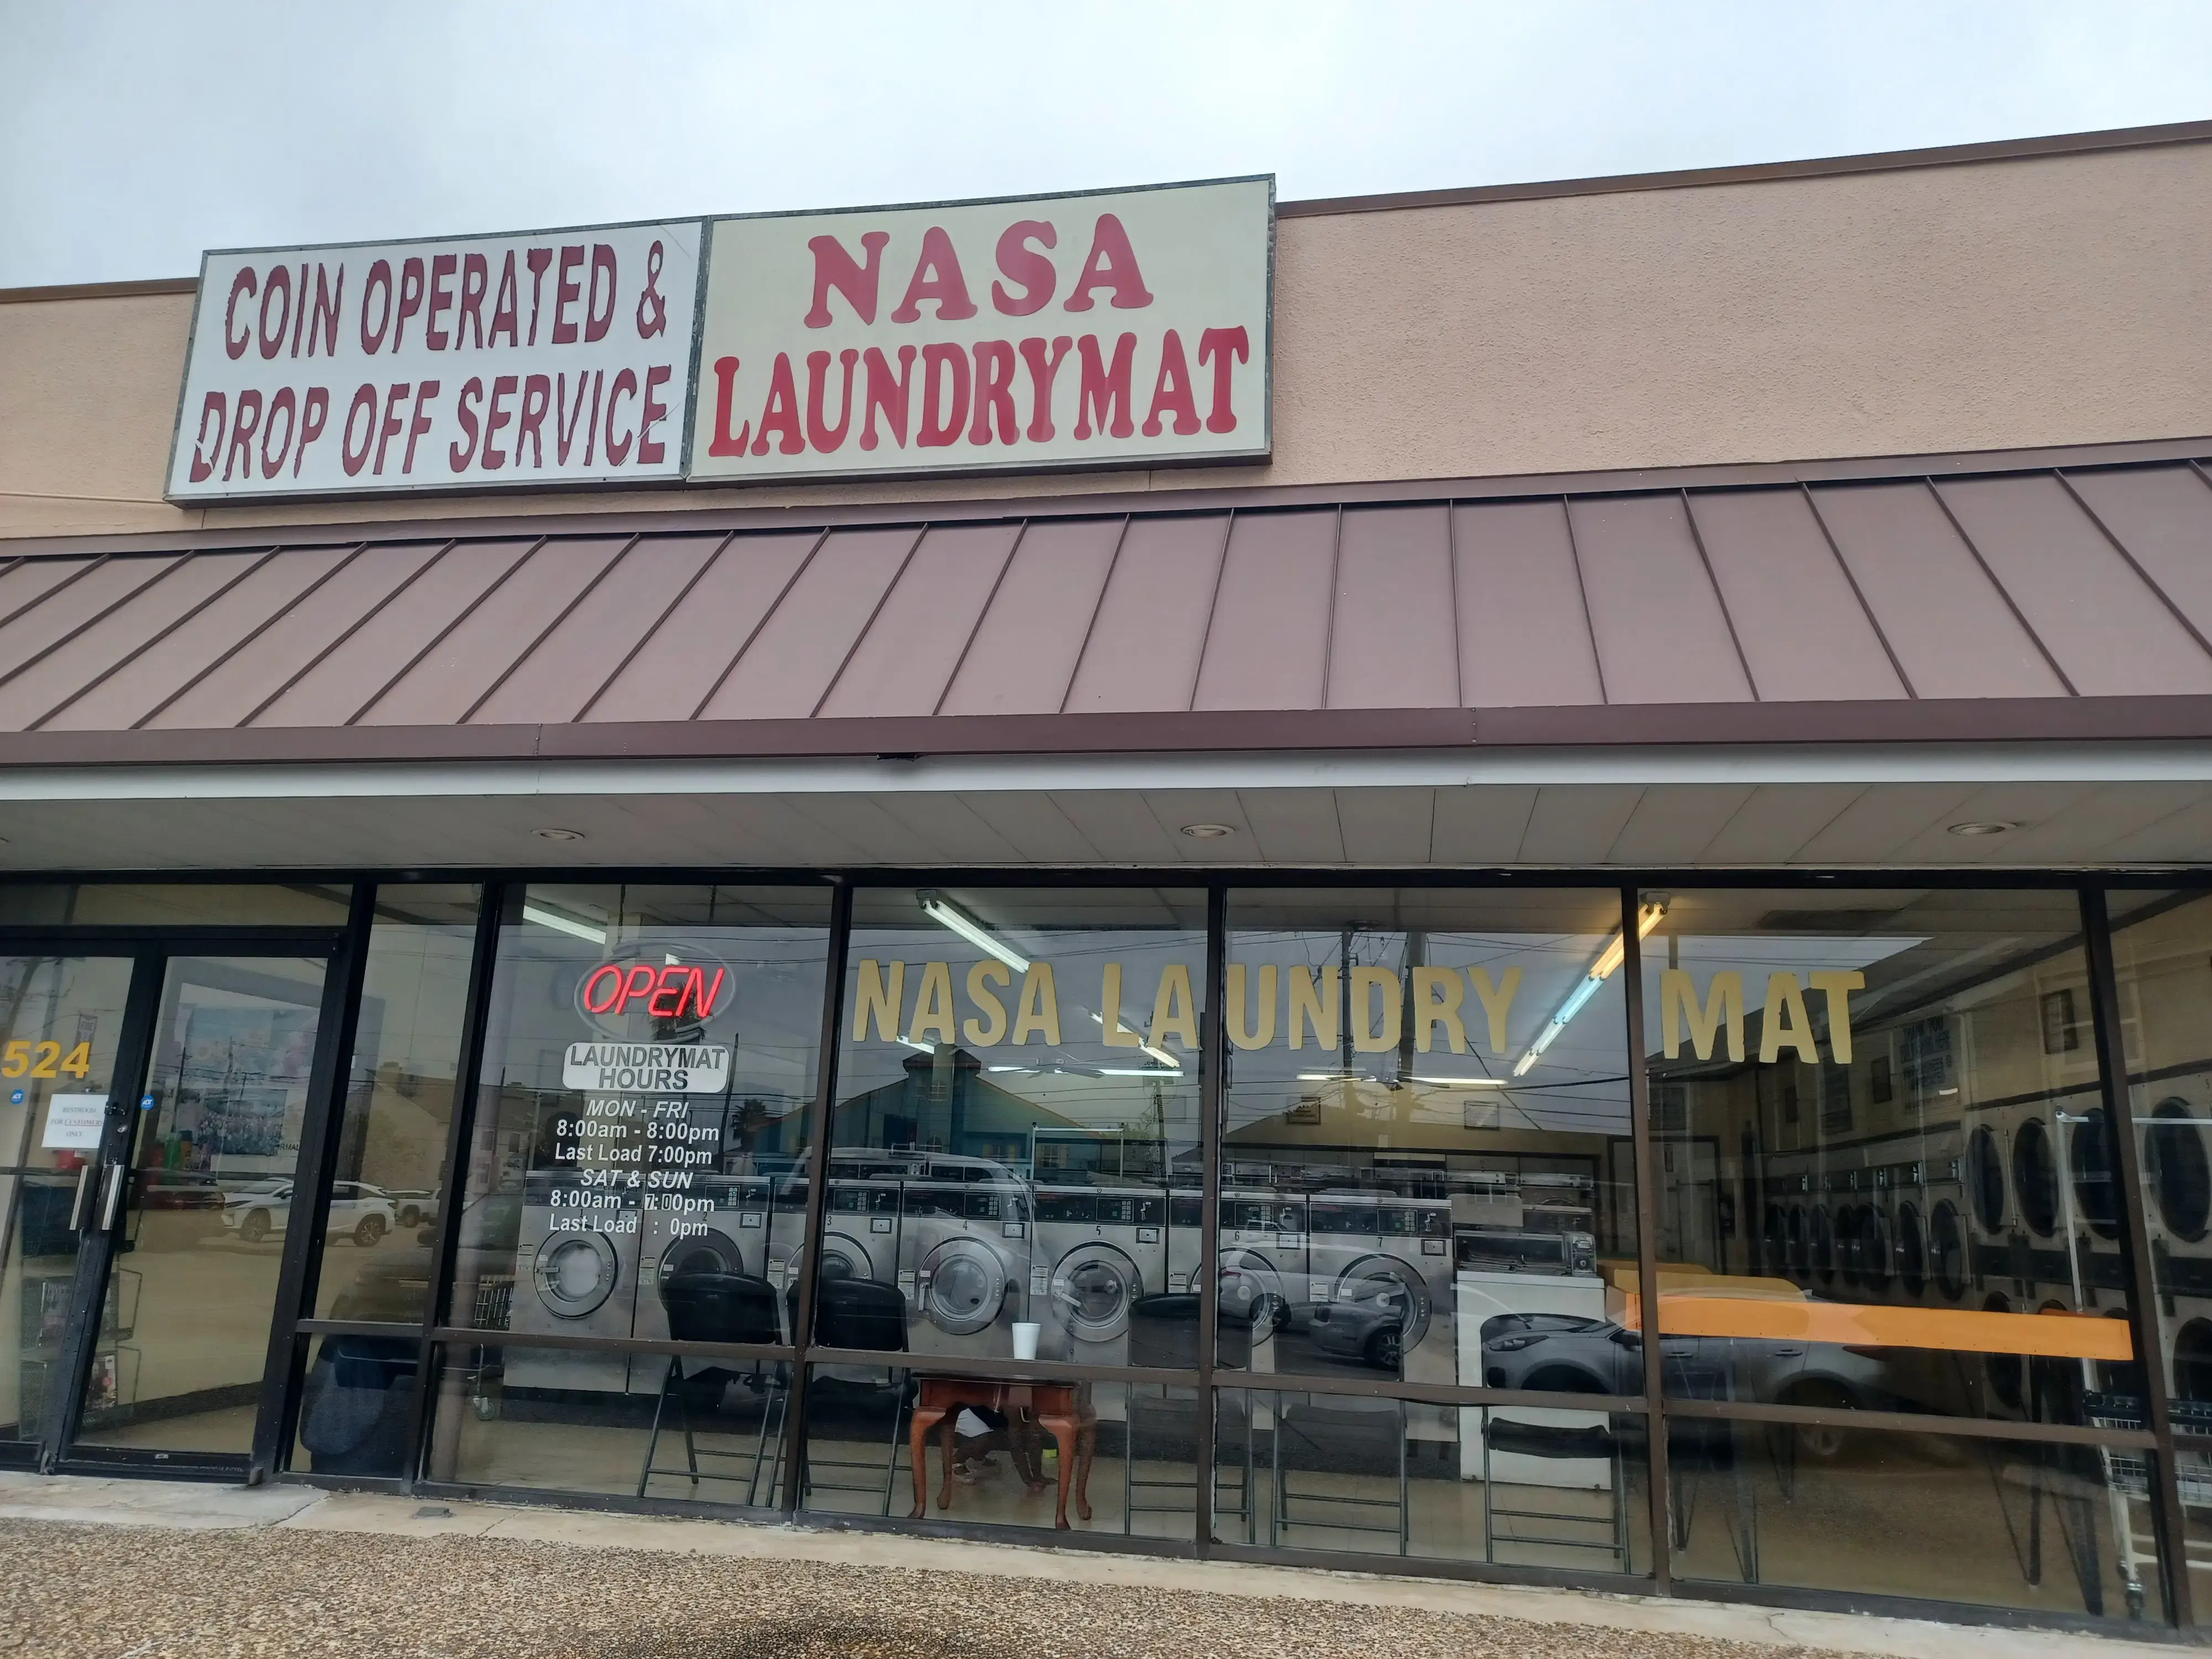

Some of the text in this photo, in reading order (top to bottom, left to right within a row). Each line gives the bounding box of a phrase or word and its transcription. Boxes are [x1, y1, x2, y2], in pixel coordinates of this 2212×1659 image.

[804, 213, 1154, 328] NASA
[225, 239, 666, 360] COIN OPERATED &
[708, 325, 1249, 458] LAUNDRYMAT
[189, 364, 671, 482] DROP OFF SERVICE
[583, 964, 724, 1018] OPEN
[852, 959, 1062, 1047] NASA
[1660, 968, 1866, 1064] MAT
[1, 1040, 91, 1079] 524
[570, 1046, 726, 1070] LAUNDRYMAT
[598, 1068, 689, 1089] HOURS
[586, 1099, 638, 1117] MON
[653, 1101, 690, 1119] FRI
[556, 1119, 627, 1139] 8:00am
[646, 1122, 719, 1144] 8:00pm
[555, 1143, 712, 1168] Last Load 7:00pm
[581, 1168, 693, 1189] SAT & SUN
[550, 1190, 622, 1209] 8:00am
[644, 1193, 715, 1215] 7:00pm
[550, 1213, 588, 1231] Last
[593, 1215, 637, 1234] Load
[702, 1212, 708, 1222] 2
[827, 1216, 832, 1226] 3
[963, 1220, 968, 1230] 4
[1096, 1225, 1101, 1236] 5
[1234, 1230, 1240, 1241] 6
[1378, 1237, 1384, 1248] 7
